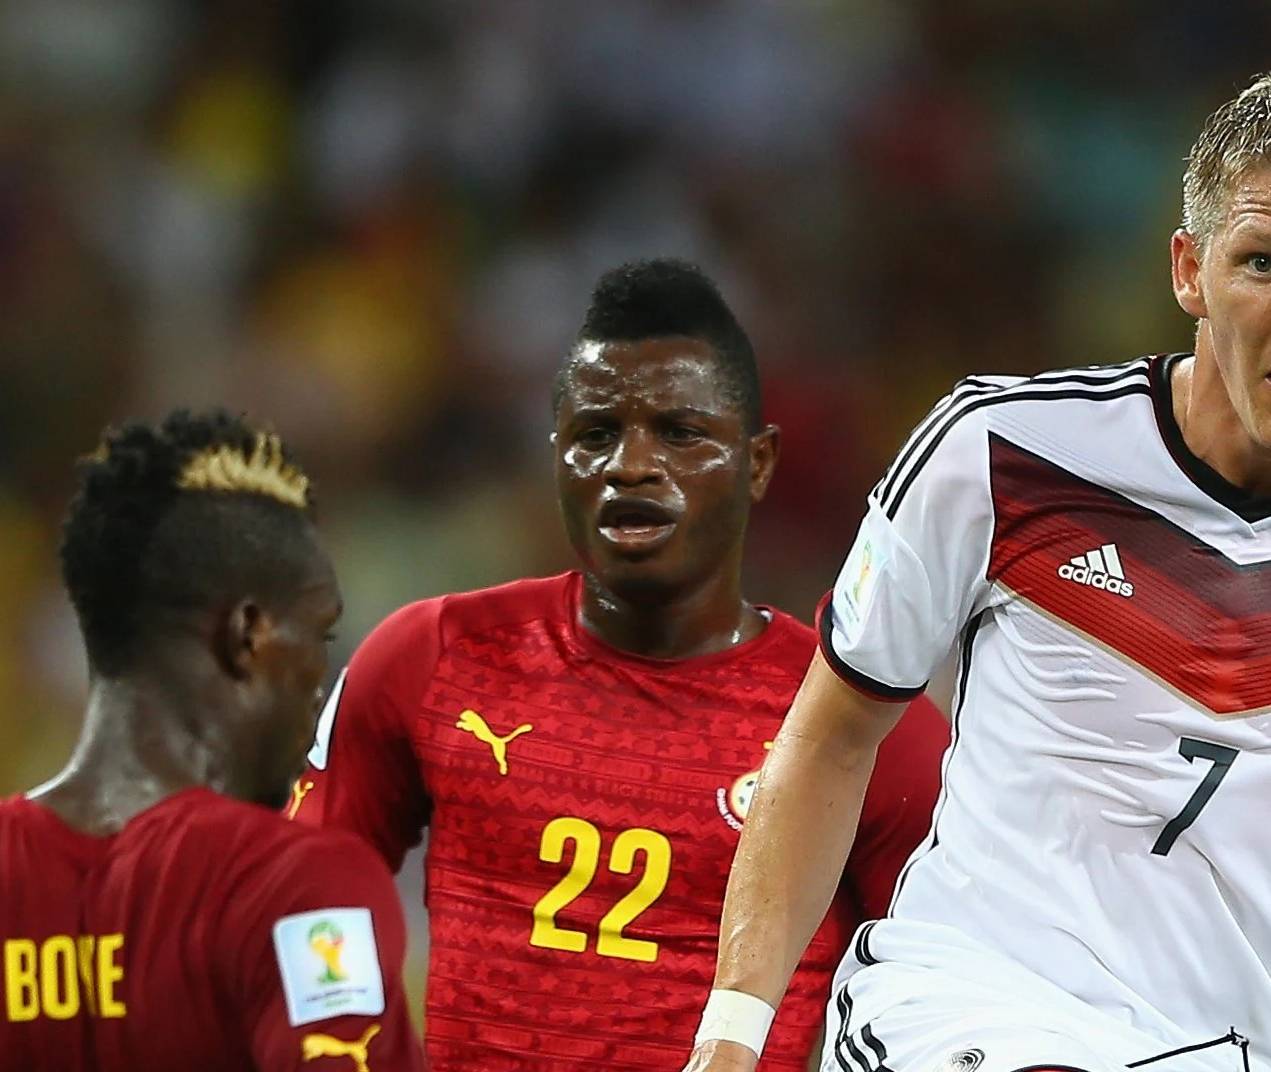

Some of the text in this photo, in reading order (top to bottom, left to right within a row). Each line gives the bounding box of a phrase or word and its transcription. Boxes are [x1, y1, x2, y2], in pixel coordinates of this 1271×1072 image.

[1058, 565, 1133, 597] adidas
[1150, 737, 1240, 856] 7
[530, 817, 672, 962] 22
